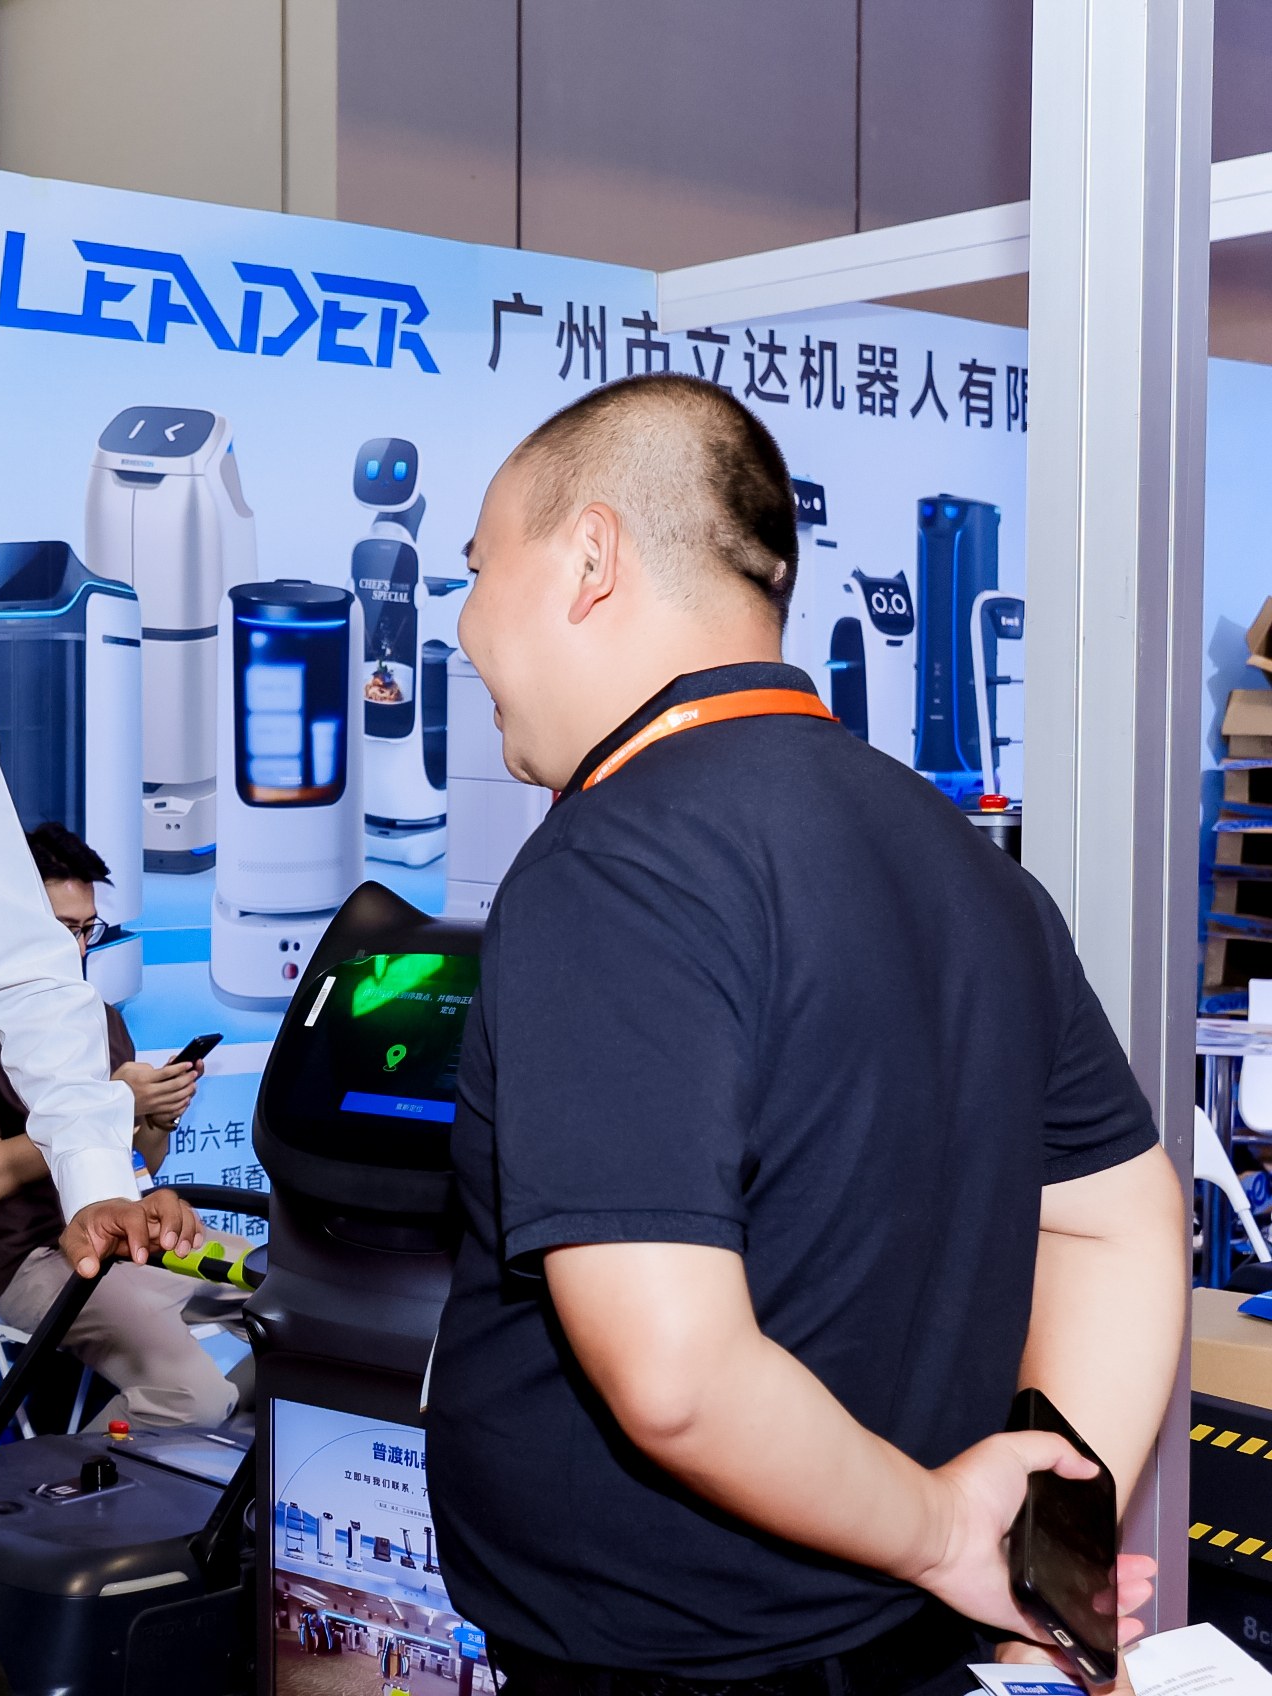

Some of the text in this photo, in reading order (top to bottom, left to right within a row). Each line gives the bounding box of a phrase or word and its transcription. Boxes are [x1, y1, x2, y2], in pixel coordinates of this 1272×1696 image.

[372, 590, 410, 603] SPECIAL
[168, 1121, 245, 1154] 的六年
